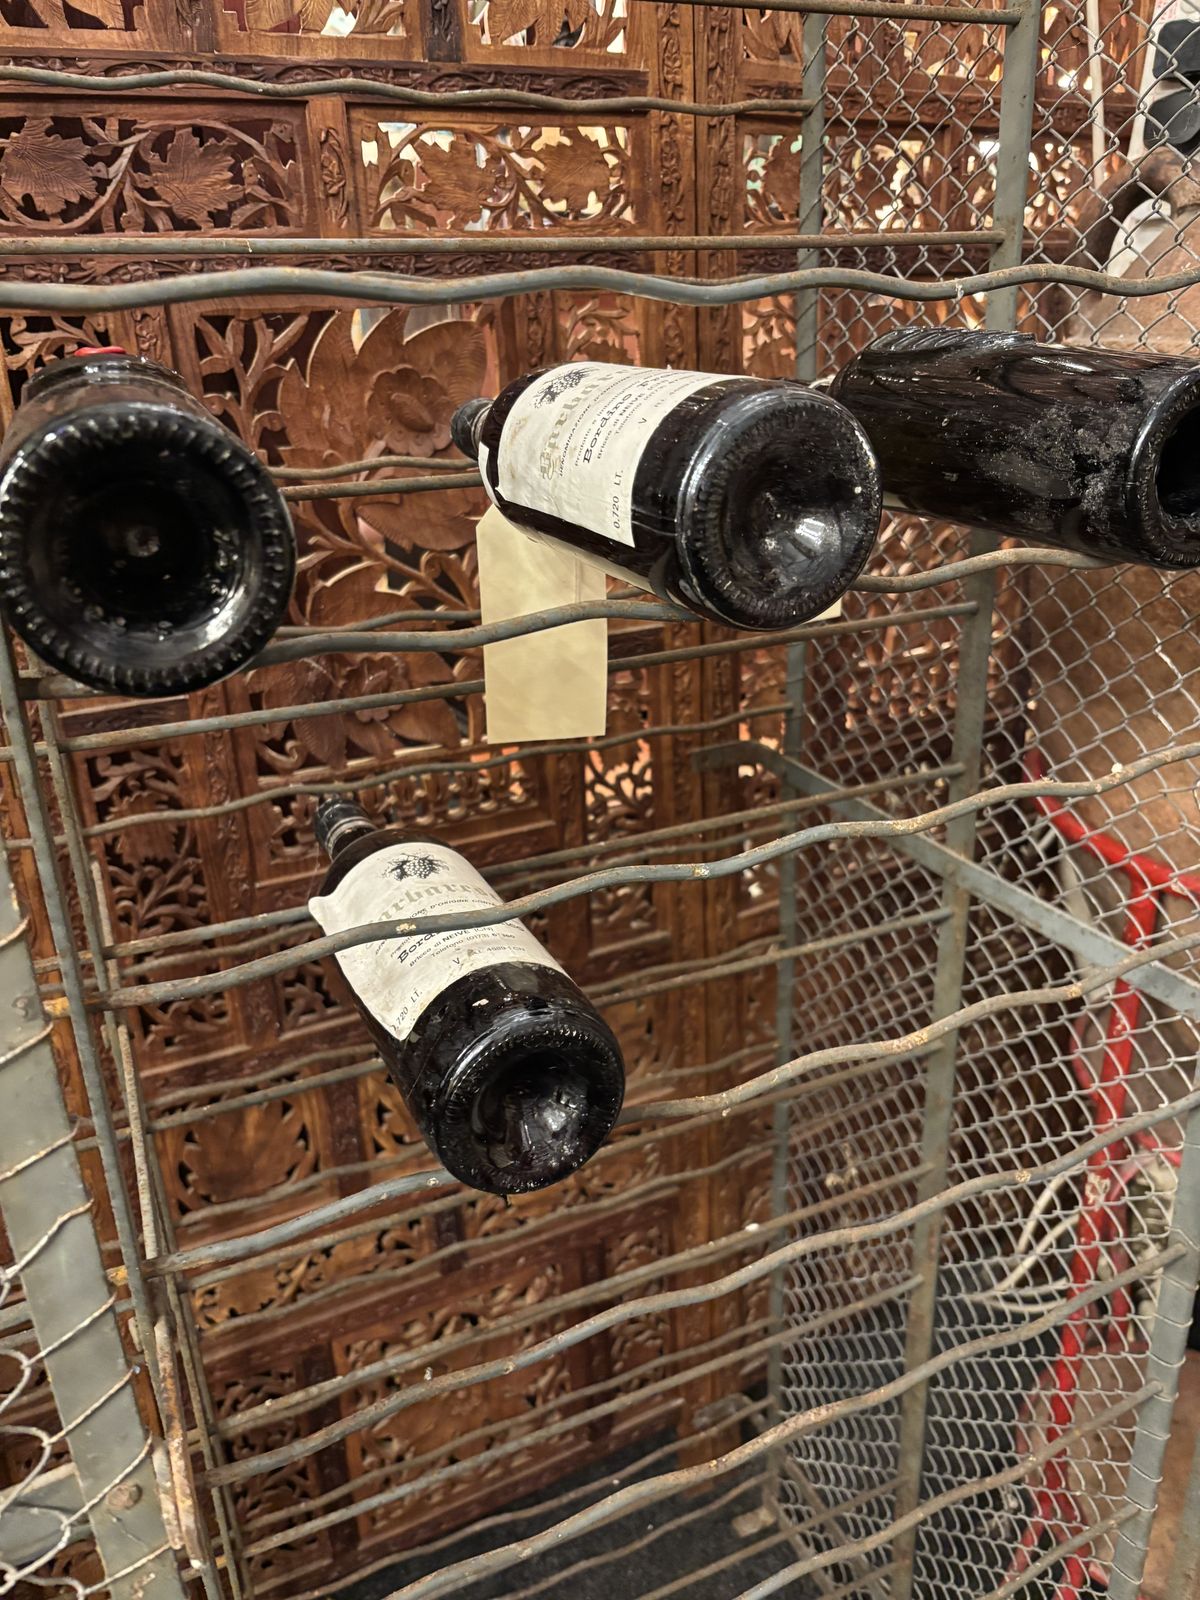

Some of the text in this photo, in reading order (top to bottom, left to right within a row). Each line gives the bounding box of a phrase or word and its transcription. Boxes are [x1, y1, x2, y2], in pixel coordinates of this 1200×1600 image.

[619, 392, 647, 416] NEIVE
[582, 393, 633, 464] Bordino
[637, 417, 648, 425] V
[613, 468, 624, 487] LT.
[397, 931, 440, 964] Bord
[409, 948, 432, 967] Bricco
[434, 940, 441, 948] di
[442, 929, 471, 943] NEIVE
[430, 938, 464, 958] Telefono
[452, 957, 461, 965] V
